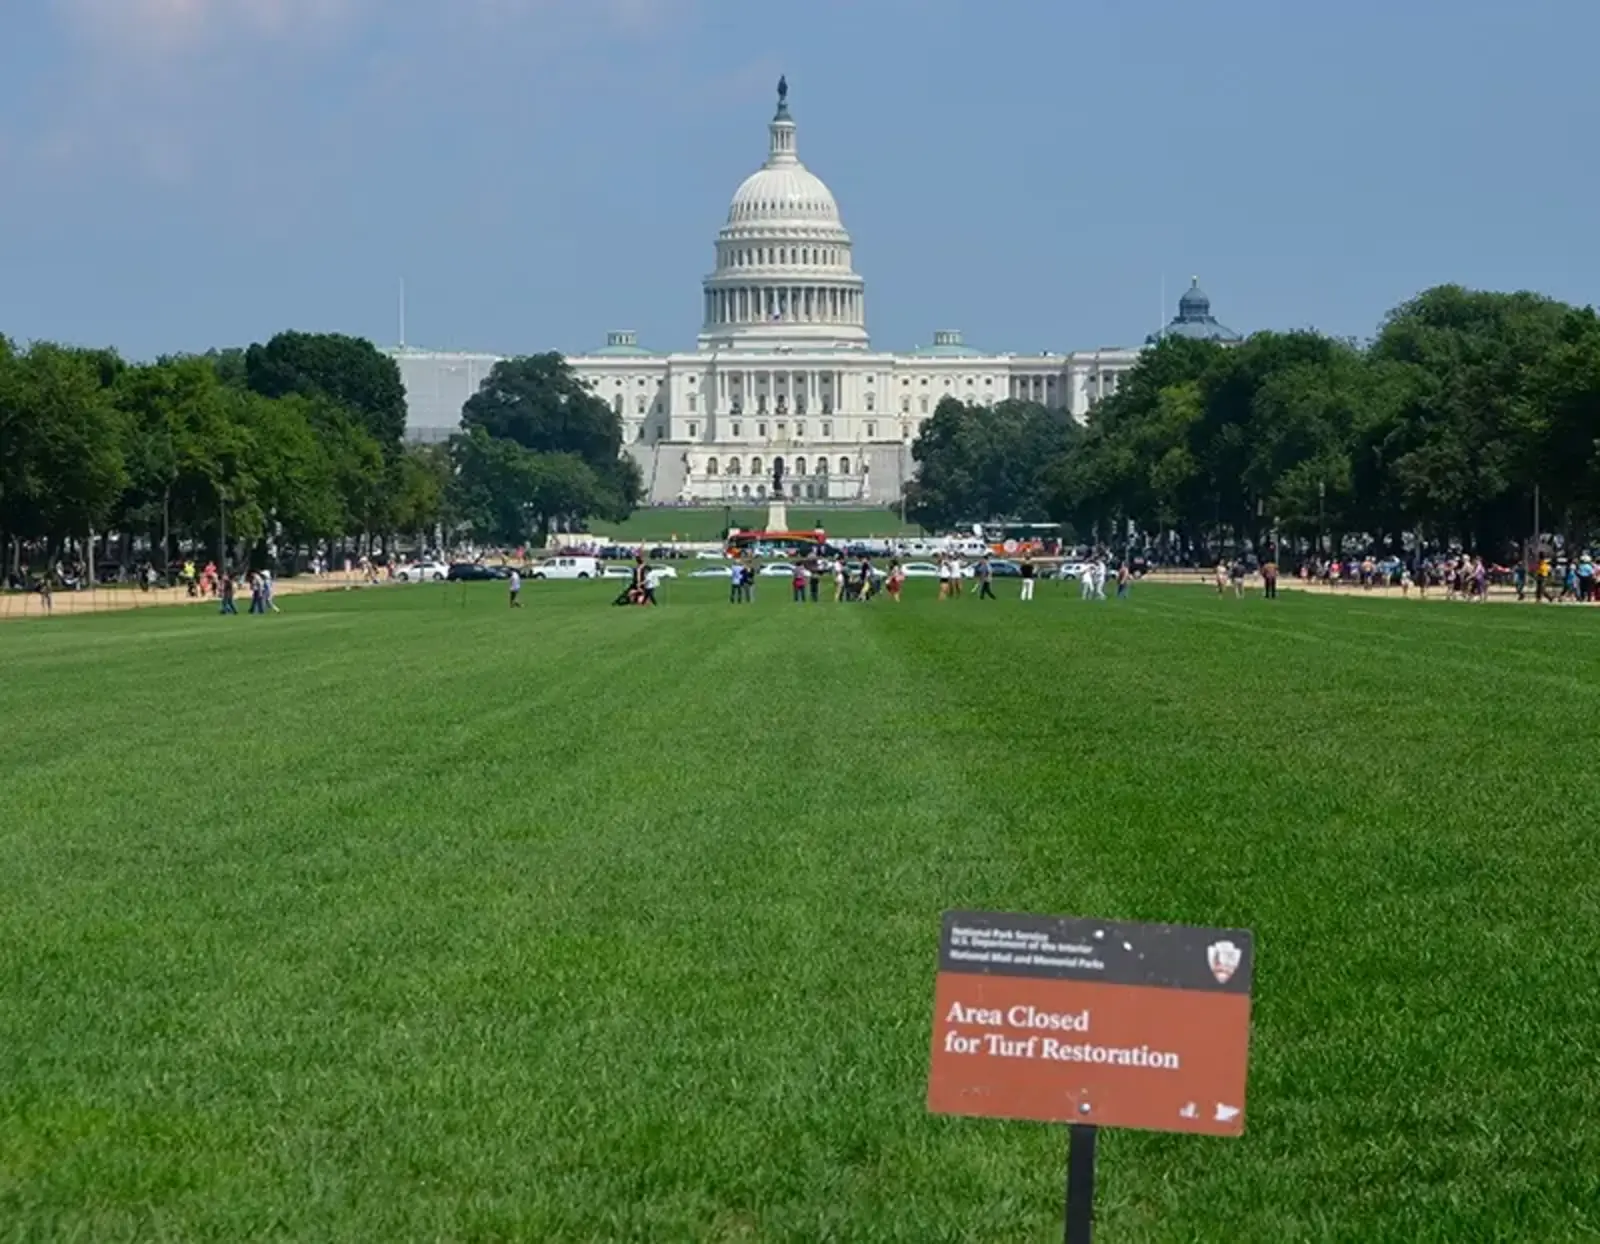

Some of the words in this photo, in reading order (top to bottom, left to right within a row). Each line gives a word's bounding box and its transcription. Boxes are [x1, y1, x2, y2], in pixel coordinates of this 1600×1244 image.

[993, 928, 1013, 939] Park
[1015, 930, 1049, 941] Service
[971, 938, 1027, 949] Department
[1028, 942, 1039, 950] of
[1041, 942, 1056, 952] the
[1058, 943, 1093, 954] Interior
[949, 949, 990, 961] National
[991, 952, 1012, 963] Mall
[1013, 954, 1032, 964] and
[1033, 955, 1077, 967] Memorial
[1079, 958, 1105, 970] Parks
[946, 1001, 1003, 1026] Area
[1008, 1005, 1089, 1032] Closed
[944, 1031, 980, 1054] for
[985, 1033, 1040, 1058] Turf
[1041, 1039, 1180, 1069] Restoration
